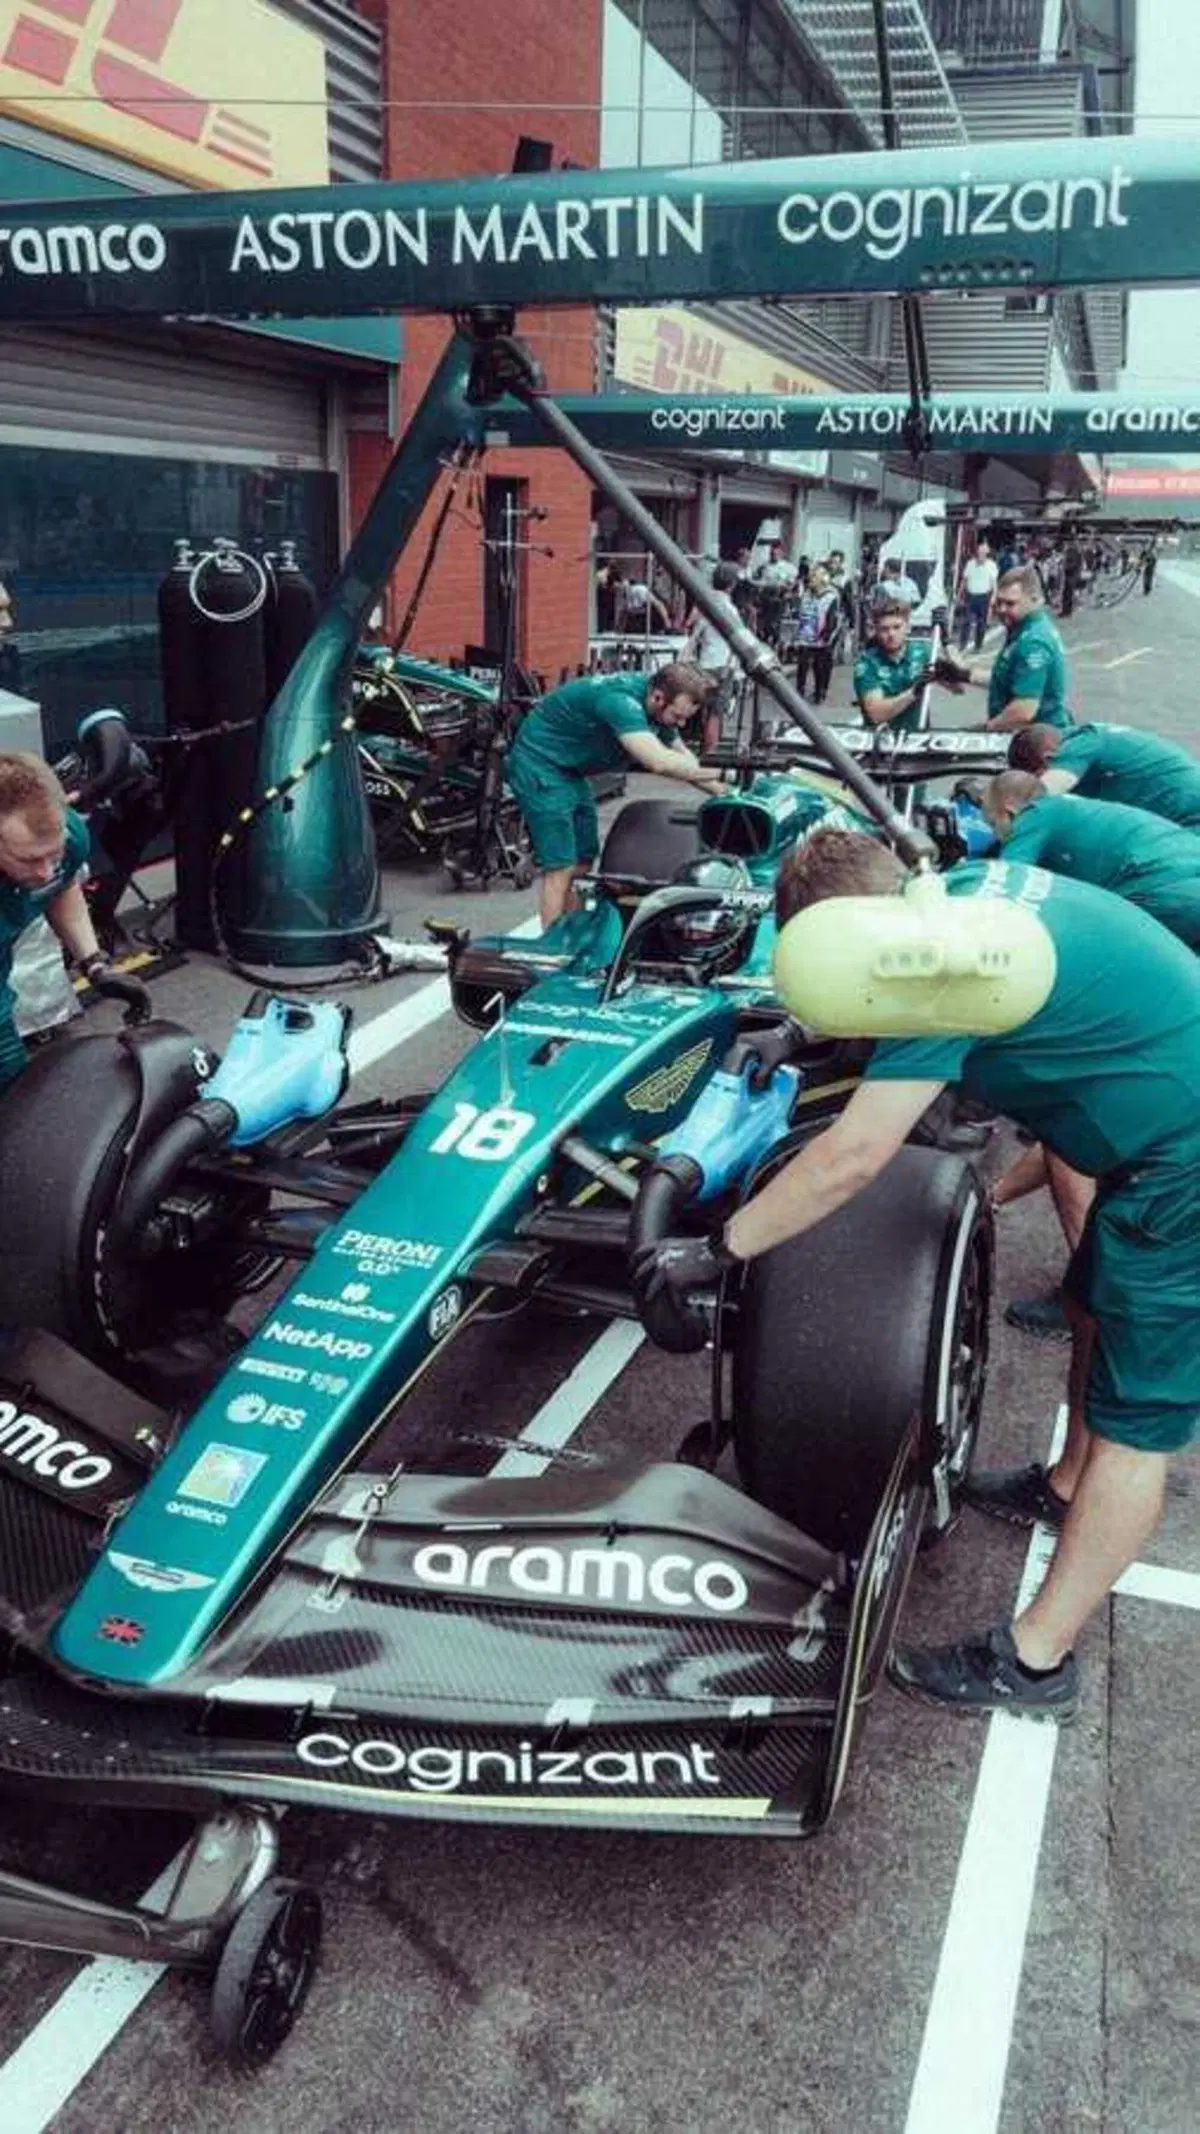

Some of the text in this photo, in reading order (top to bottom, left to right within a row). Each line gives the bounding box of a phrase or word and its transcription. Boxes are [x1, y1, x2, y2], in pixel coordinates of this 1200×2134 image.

[230, 208, 428, 273] ASTON
[452, 193, 704, 264] MARTIN
[777, 164, 1134, 260] cognizant
[651, 402, 787, 438] cognizant
[929, 405, 1055, 435] MARTIN
[1086, 406, 1200, 432] aramc
[364, 781, 391, 796] OSS
[427, 1100, 537, 1161] 18
[337, 1228, 443, 1265] PERONI
[262, 1321, 373, 1361] NetApp
[260, 1402, 308, 1431] IFS
[165, 1500, 229, 1526] aramco
[411, 1541, 748, 1613] aramco
[295, 1730, 720, 1790] cognizant
